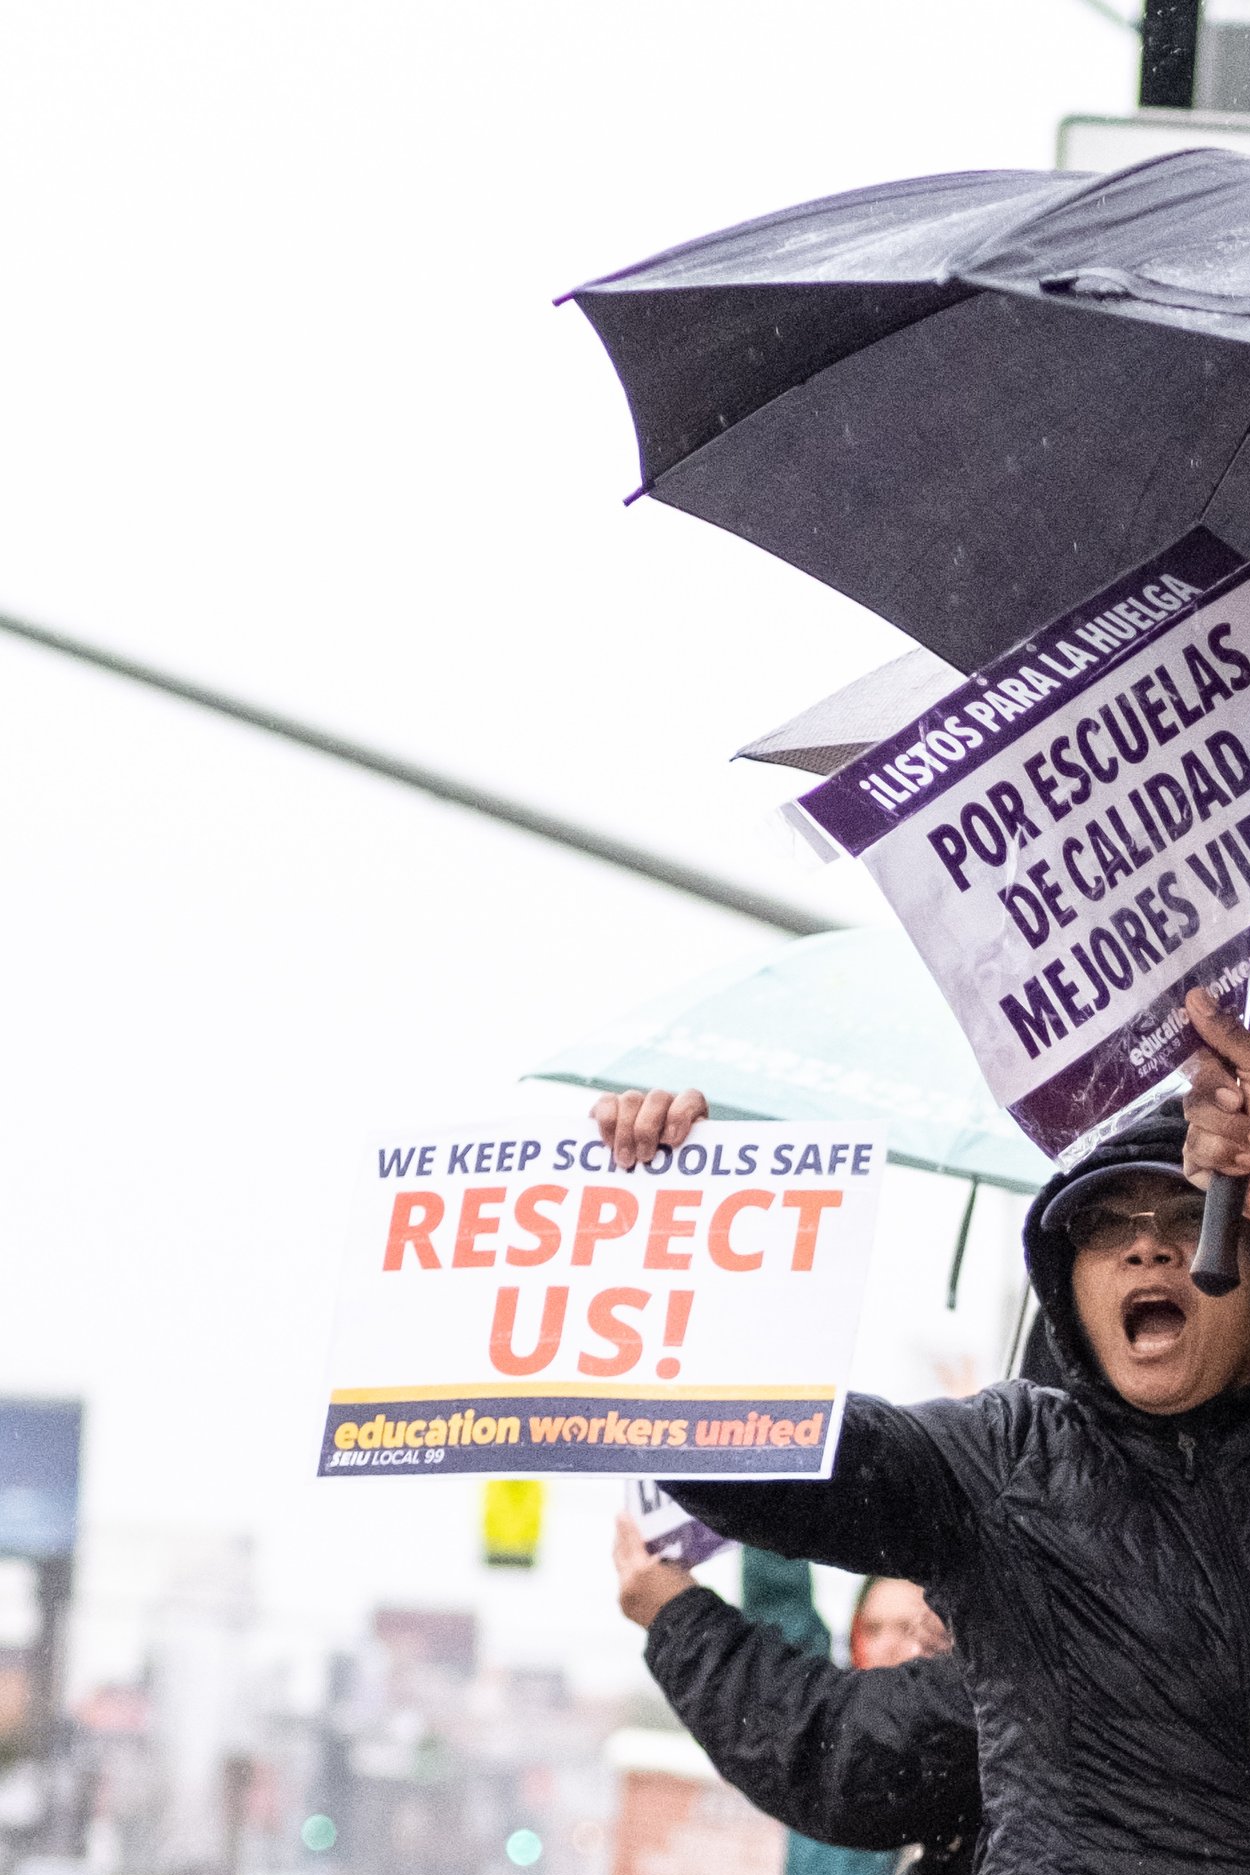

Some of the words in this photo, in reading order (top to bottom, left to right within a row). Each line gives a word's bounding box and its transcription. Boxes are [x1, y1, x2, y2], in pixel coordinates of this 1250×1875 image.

[964, 666, 1061, 732] PARA
[1038, 640, 1098, 679] LA
[1075, 573, 1203, 654] HUELGA
[927, 780, 1042, 893] POR
[997, 859, 1078, 949] DE
[999, 871, 1200, 1059] MEJORES
[1130, 1007, 1190, 1066] educatio
[378, 1146, 435, 1179] WE
[447, 1140, 541, 1175] KEEP
[770, 1143, 873, 1176] SAFE
[382, 1184, 843, 1273] RESPECT
[488, 1286, 695, 1380] US!
[330, 1451, 371, 1467] SEIU
[371, 1450, 420, 1466] LOCAL
[424, 1448, 445, 1464] 99
[334, 1408, 521, 1450] education
[529, 1408, 688, 1446] workers
[695, 1411, 823, 1447] united
